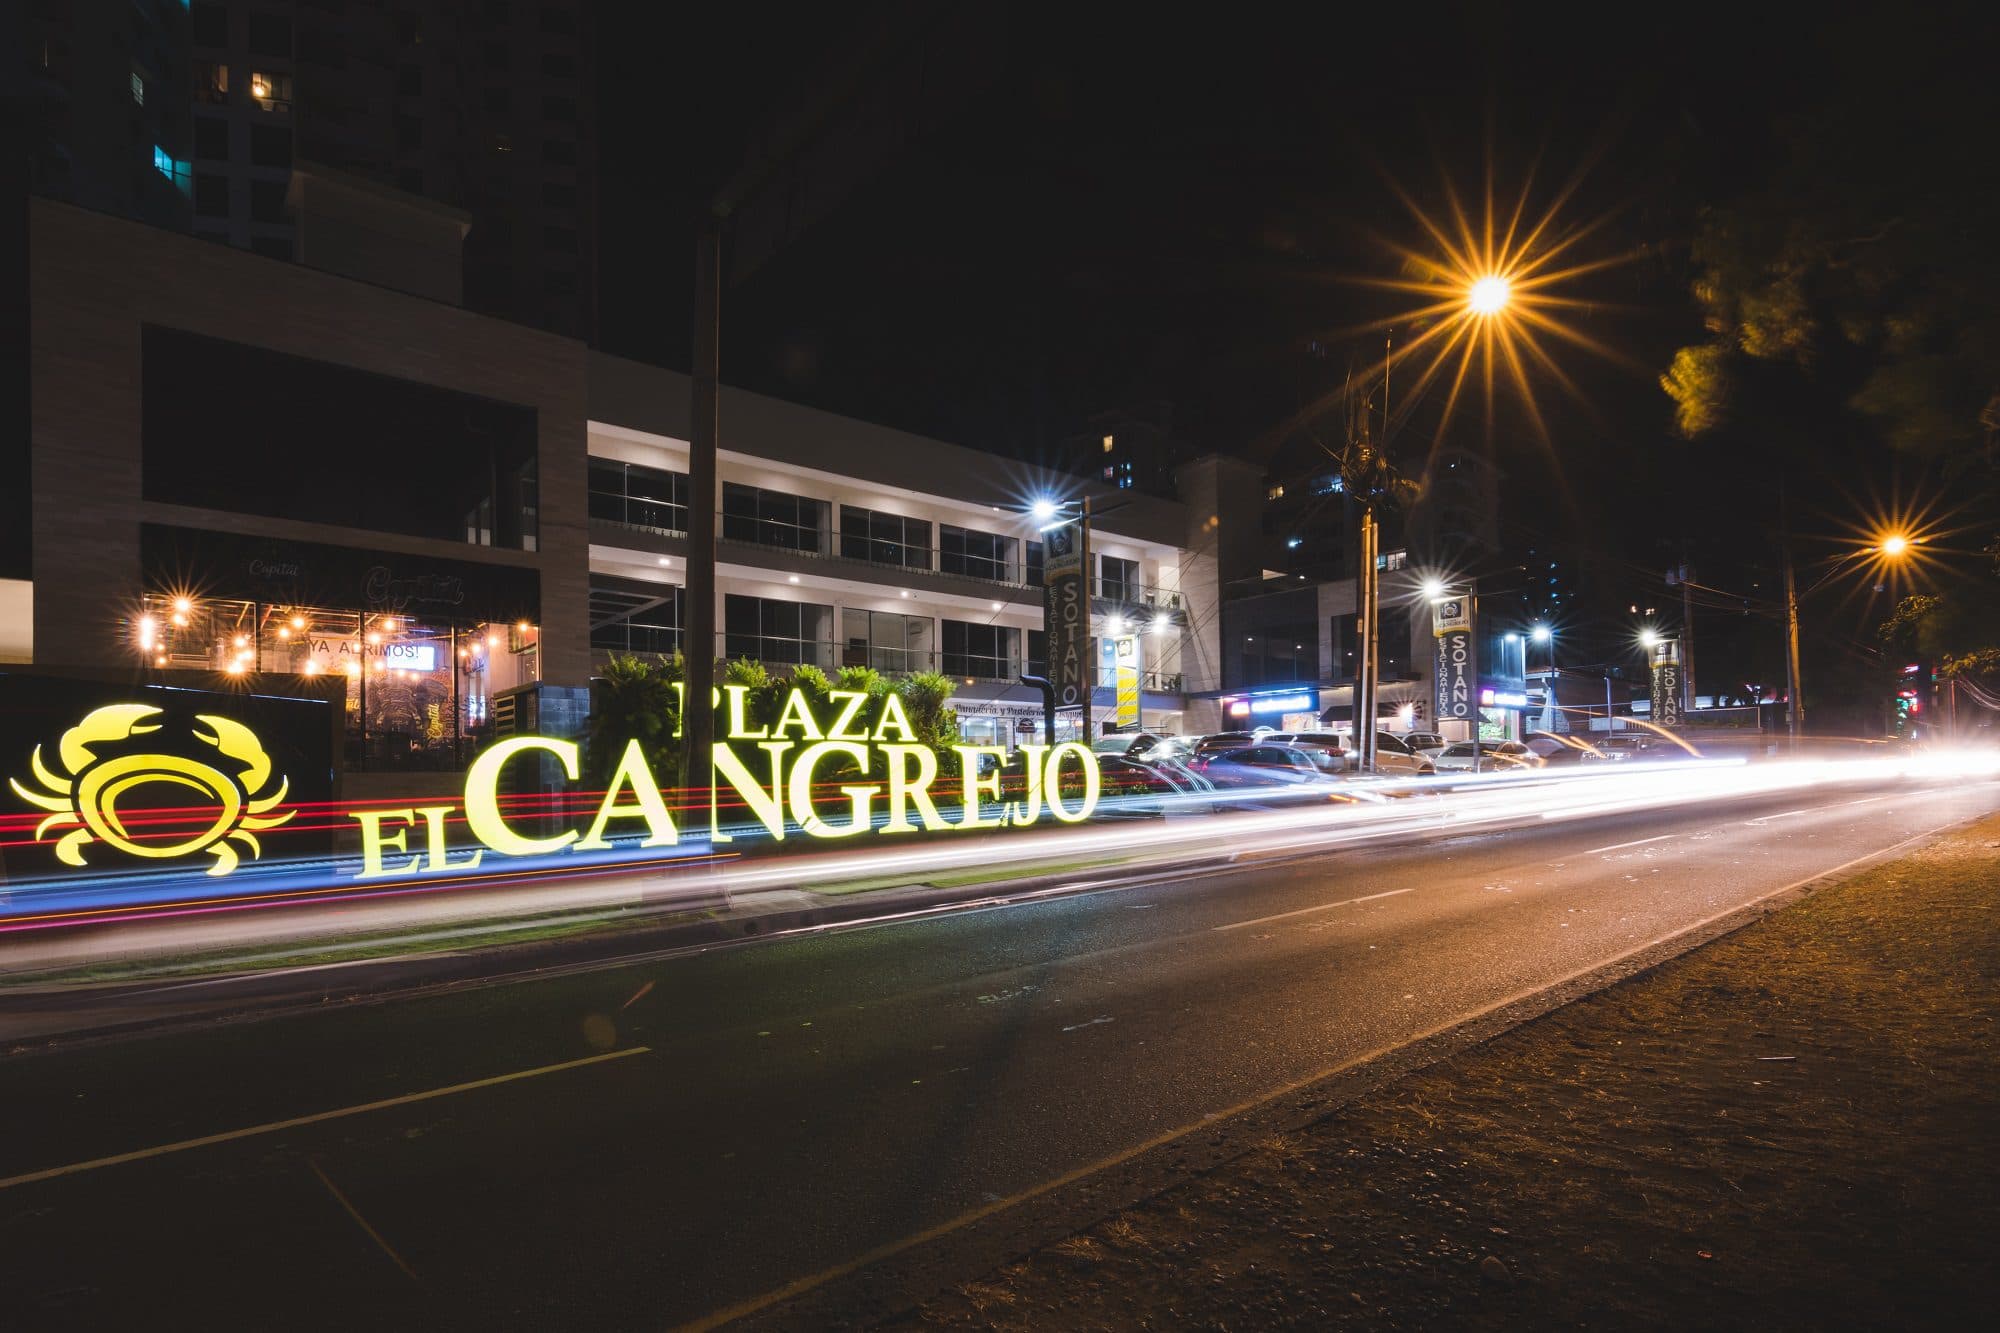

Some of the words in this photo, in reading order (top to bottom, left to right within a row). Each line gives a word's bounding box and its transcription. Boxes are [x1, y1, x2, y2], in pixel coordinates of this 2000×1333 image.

[309, 639, 330, 653] YA
[1063, 582, 1079, 704] SOTANO
[1452, 635, 1468, 716] SOTANO
[1664, 667, 1677, 725] SOTANO
[348, 806, 483, 879] EL
[464, 736, 1101, 856] CANGREJO
